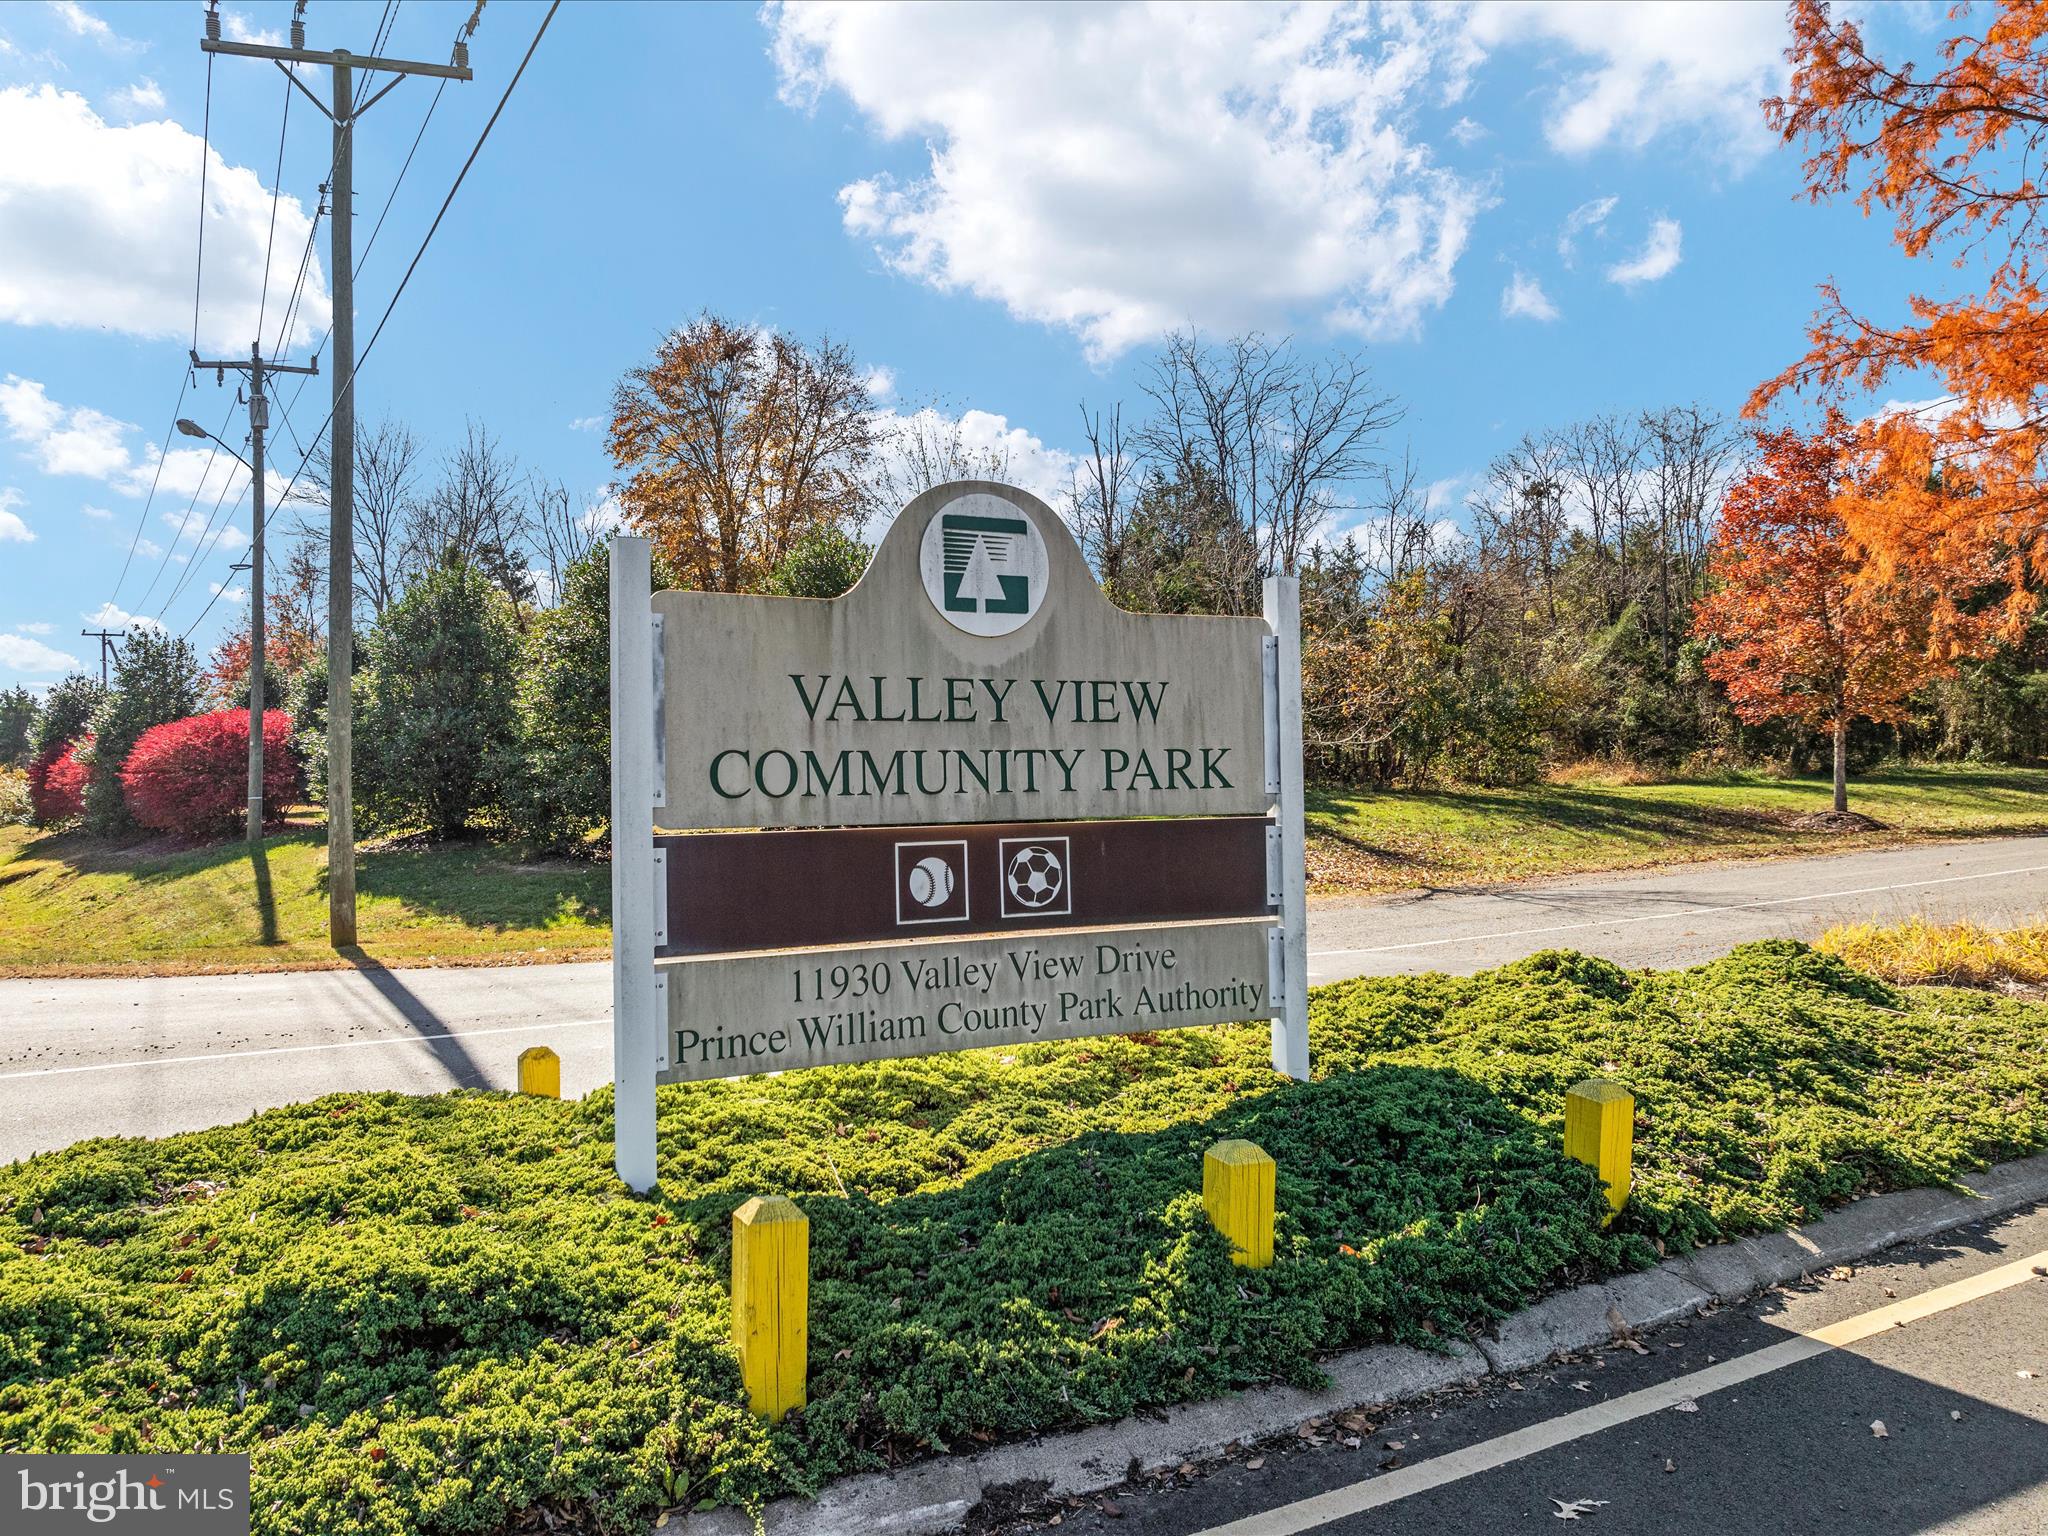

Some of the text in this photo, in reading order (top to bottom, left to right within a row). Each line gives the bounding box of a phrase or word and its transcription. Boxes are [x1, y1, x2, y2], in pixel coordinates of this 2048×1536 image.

[788, 674, 1169, 724] VALLEY VIEW
[709, 747, 1234, 799] COMMUNITY PARK
[792, 942, 1177, 1003] 11930 Valley View Drive
[675, 977, 1264, 1065] Prince William County Park Authority
